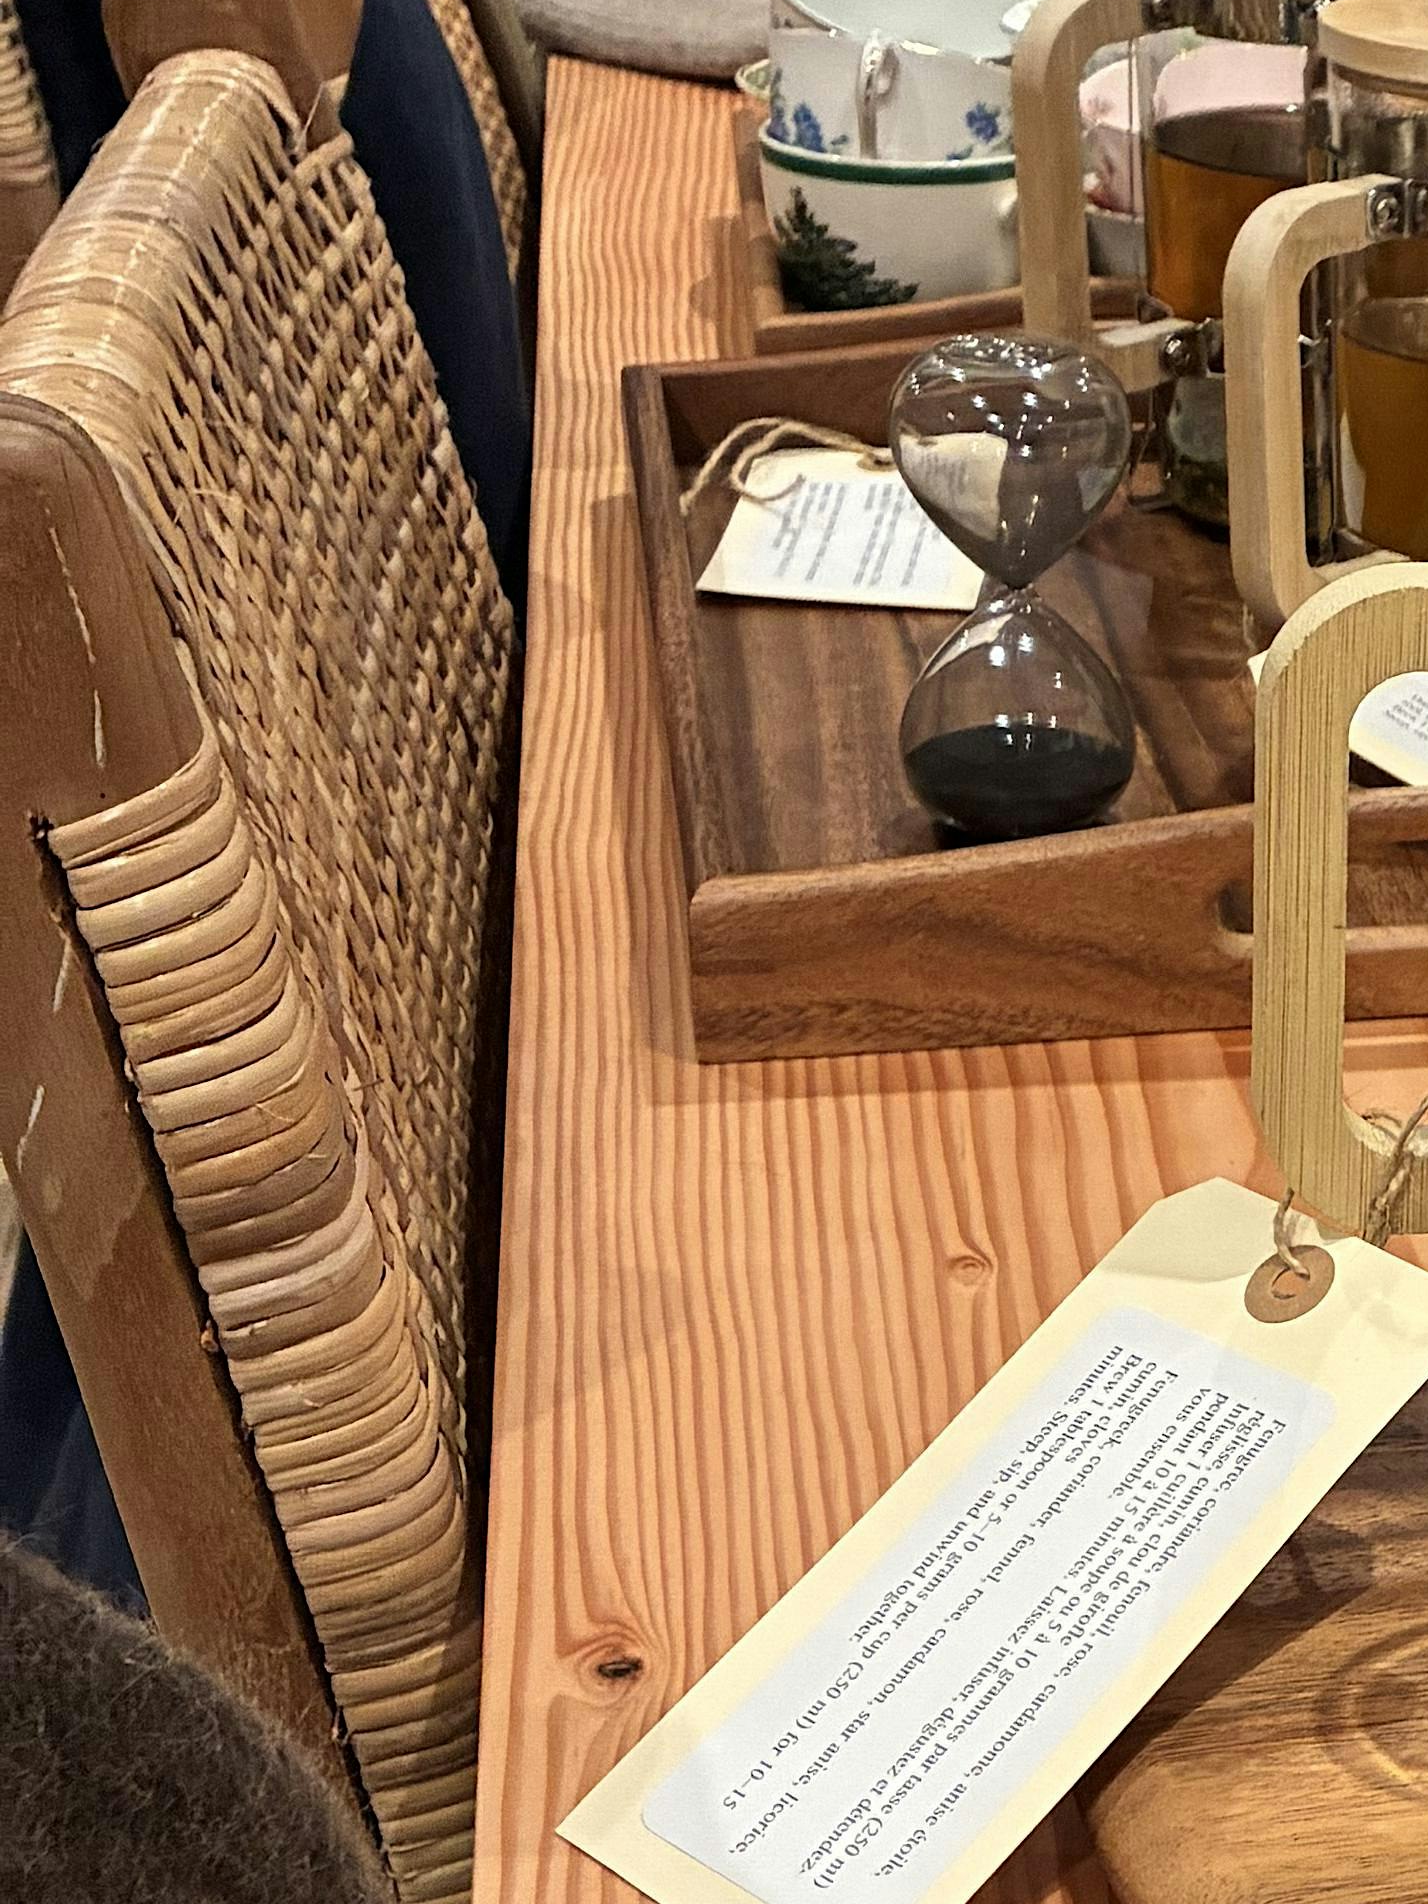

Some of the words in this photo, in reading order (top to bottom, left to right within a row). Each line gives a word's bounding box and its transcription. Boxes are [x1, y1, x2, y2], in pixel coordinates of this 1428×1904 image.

[1102, 1352, 1144, 1394] Brew
[1174, 1387, 1212, 1422] vous
[1063, 1414, 1111, 1464] cloves
[1171, 1391, 1230, 1455] pendant
[1196, 1401, 1250, 1458] Infuser
[1014, 1409, 1093, 1491] tablespoon
[1154, 1458, 1178, 1479] 10
[964, 1488, 996, 1520] and
[998, 1492, 1018, 1512] or
[1123, 1494, 1147, 1516] 15
[1132, 1472, 1187, 1532] cuillère
[911, 1520, 968, 1579] unwind
[1126, 1532, 1161, 1568] clou
[915, 1550, 963, 1601] grams
[1078, 1545, 1124, 1594] soupe
[1107, 1569, 1130, 1591] de
[890, 1599, 919, 1630] per
[1006, 1584, 1068, 1645] Laissez
[1057, 1595, 1081, 1617] ou
[860, 1630, 891, 1660] cup
[1014, 1647, 1039, 1669] 10
[824, 1660, 864, 1700] (250
[794, 1698, 827, 1730] ml)
[945, 1667, 1015, 1743] grammes
[770, 1730, 799, 1757] for
[839, 1709, 871, 1743] star
[885, 1705, 955, 1777] dégustez
[919, 1741, 949, 1774] par
[868, 1777, 889, 1796] et
[879, 1773, 923, 1815] tasse
[923, 1782, 968, 1827] anise
[843, 1816, 883, 1857] (250
[812, 1857, 845, 1889] ml)
